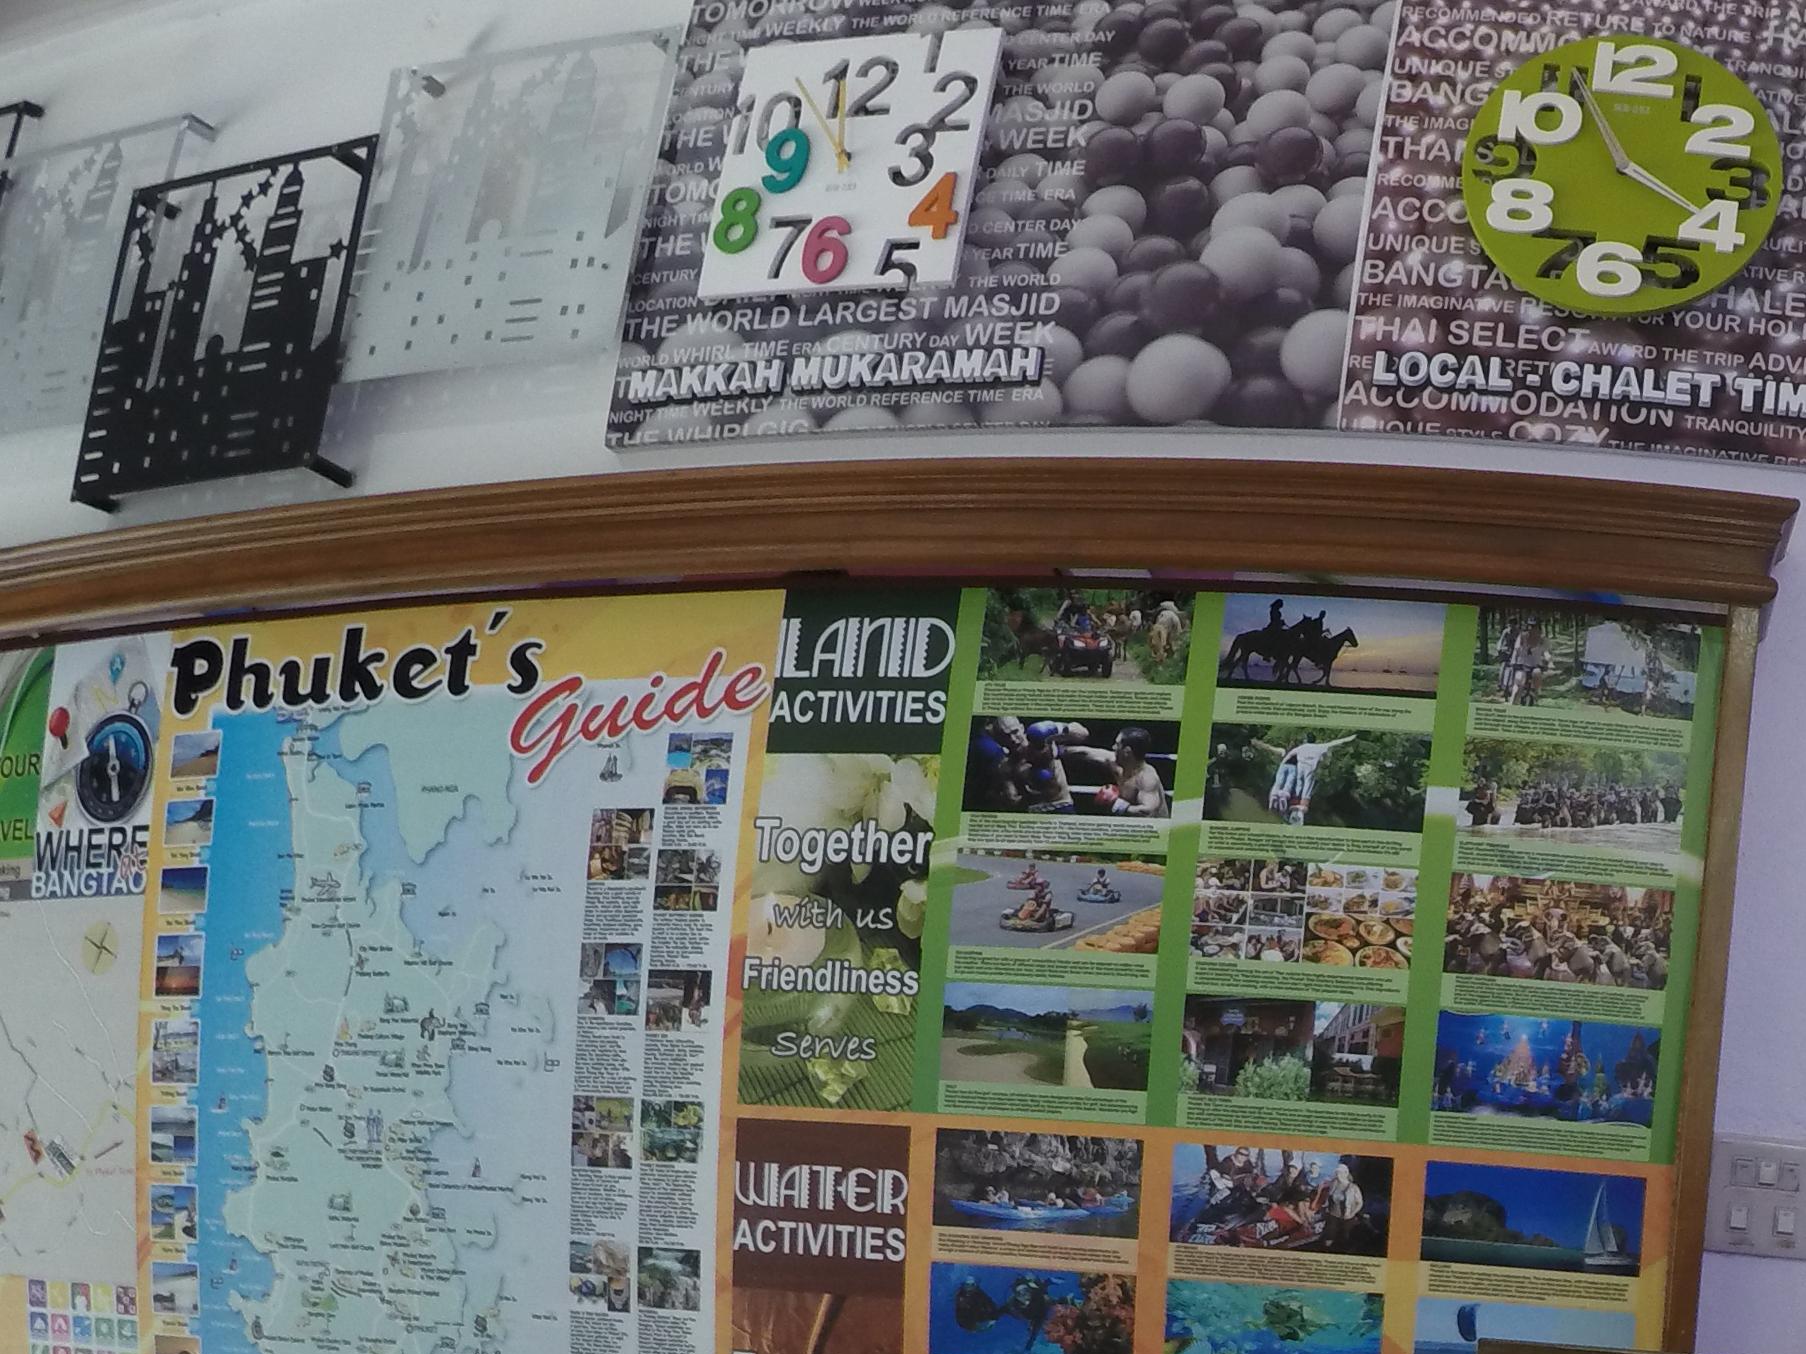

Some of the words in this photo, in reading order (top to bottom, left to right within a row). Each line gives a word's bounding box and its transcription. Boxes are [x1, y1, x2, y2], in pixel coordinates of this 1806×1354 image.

[766, 14, 845, 37] WEEKLY
[851, 15, 880, 29] THE
[883, 11, 937, 27] WORLD
[941, 5, 1032, 23] REFERENCE
[1034, 4, 1073, 18] TIME
[1402, 4, 1541, 25] RECOMMENDED
[1652, 22, 1676, 35] TO
[1680, 24, 1751, 44] NATURE
[1007, 57, 1049, 72] YEAR
[1051, 51, 1103, 69] TIME
[1393, 57, 1491, 79] UNIQUE
[1592, 41, 1679, 98] 12
[822, 55, 900, 120] 12
[932, 70, 979, 132] 2
[1035, 80, 1096, 95] WORLD
[662, 125, 717, 151] THE
[999, 125, 1089, 151] WEEK
[1384, 113, 1420, 129] THE
[1498, 90, 1584, 147] 10
[1684, 104, 1756, 160] 2
[761, 129, 811, 194] 9
[887, 122, 937, 188] 3
[1034, 159, 1087, 178] TIME
[907, 172, 960, 240] 4
[1486, 178, 1555, 234] 8
[1705, 156, 1771, 212] 3
[712, 185, 762, 254] 8
[1050, 217, 1082, 232] DAY
[1367, 231, 1466, 255] UNIQUE
[1677, 198, 1747, 254] 4
[640, 232, 695, 259] THE
[767, 216, 812, 280] 7
[801, 215, 855, 285] 6
[1016, 241, 1070, 260] TIME
[1575, 240, 1645, 298] 6
[632, 267, 699, 286] CENTURY
[968, 274, 999, 288] THE
[1002, 272, 1062, 287] WORLD
[625, 314, 681, 341] THE
[686, 305, 791, 335] WORLD
[797, 295, 938, 328] LARGEST
[944, 291, 1063, 320] MASJID
[628, 295, 698, 315] LOCATION
[1358, 291, 1393, 308] THE
[1396, 293, 1516, 315] IMAGINATIVE
[1671, 310, 1741, 334] YOUR
[618, 353, 669, 370] WORLD
[672, 343, 734, 365] WHIRL
[743, 339, 790, 359] TIME
[792, 341, 822, 357] ERA
[826, 331, 928, 353] CENTURY
[929, 334, 960, 349] DAY
[964, 320, 1058, 347] WEEK
[1355, 314, 1438, 344] THAI
[1447, 319, 1592, 354] SELECT
[1588, 341, 1657, 360] AWARD
[1662, 346, 1700, 364] THE
[1702, 350, 1745, 368] TRIP
[628, 357, 786, 405] MAKKAH
[790, 346, 1044, 392] MUKARAMAH
[1373, 350, 1514, 393] LOCAL
[1551, 360, 1721, 408] CHALET
[609, 408, 651, 425] NIGHT
[693, 396, 774, 418] WEEKLY
[779, 397, 808, 411] THE
[811, 393, 867, 409] WORLD
[872, 390, 963, 407] REFERENCE
[967, 389, 1004, 403] TIME
[1011, 387, 1044, 402] ERA
[170, 610, 543, 718] Phuket's
[774, 616, 957, 679] LAND
[509, 647, 770, 786] Guide
[768, 690, 948, 724] ACTIVITIES
[35, 824, 151, 874] WHERE
[754, 816, 934, 873] Together
[31, 869, 148, 900] BANGTAO
[772, 898, 844, 930] with
[855, 903, 895, 930] us
[741, 956, 920, 995] Friendliness
[770, 1030, 878, 1062] Serves
[734, 1159, 909, 1215] WATER
[732, 1217, 908, 1262] ACTIVITIES
